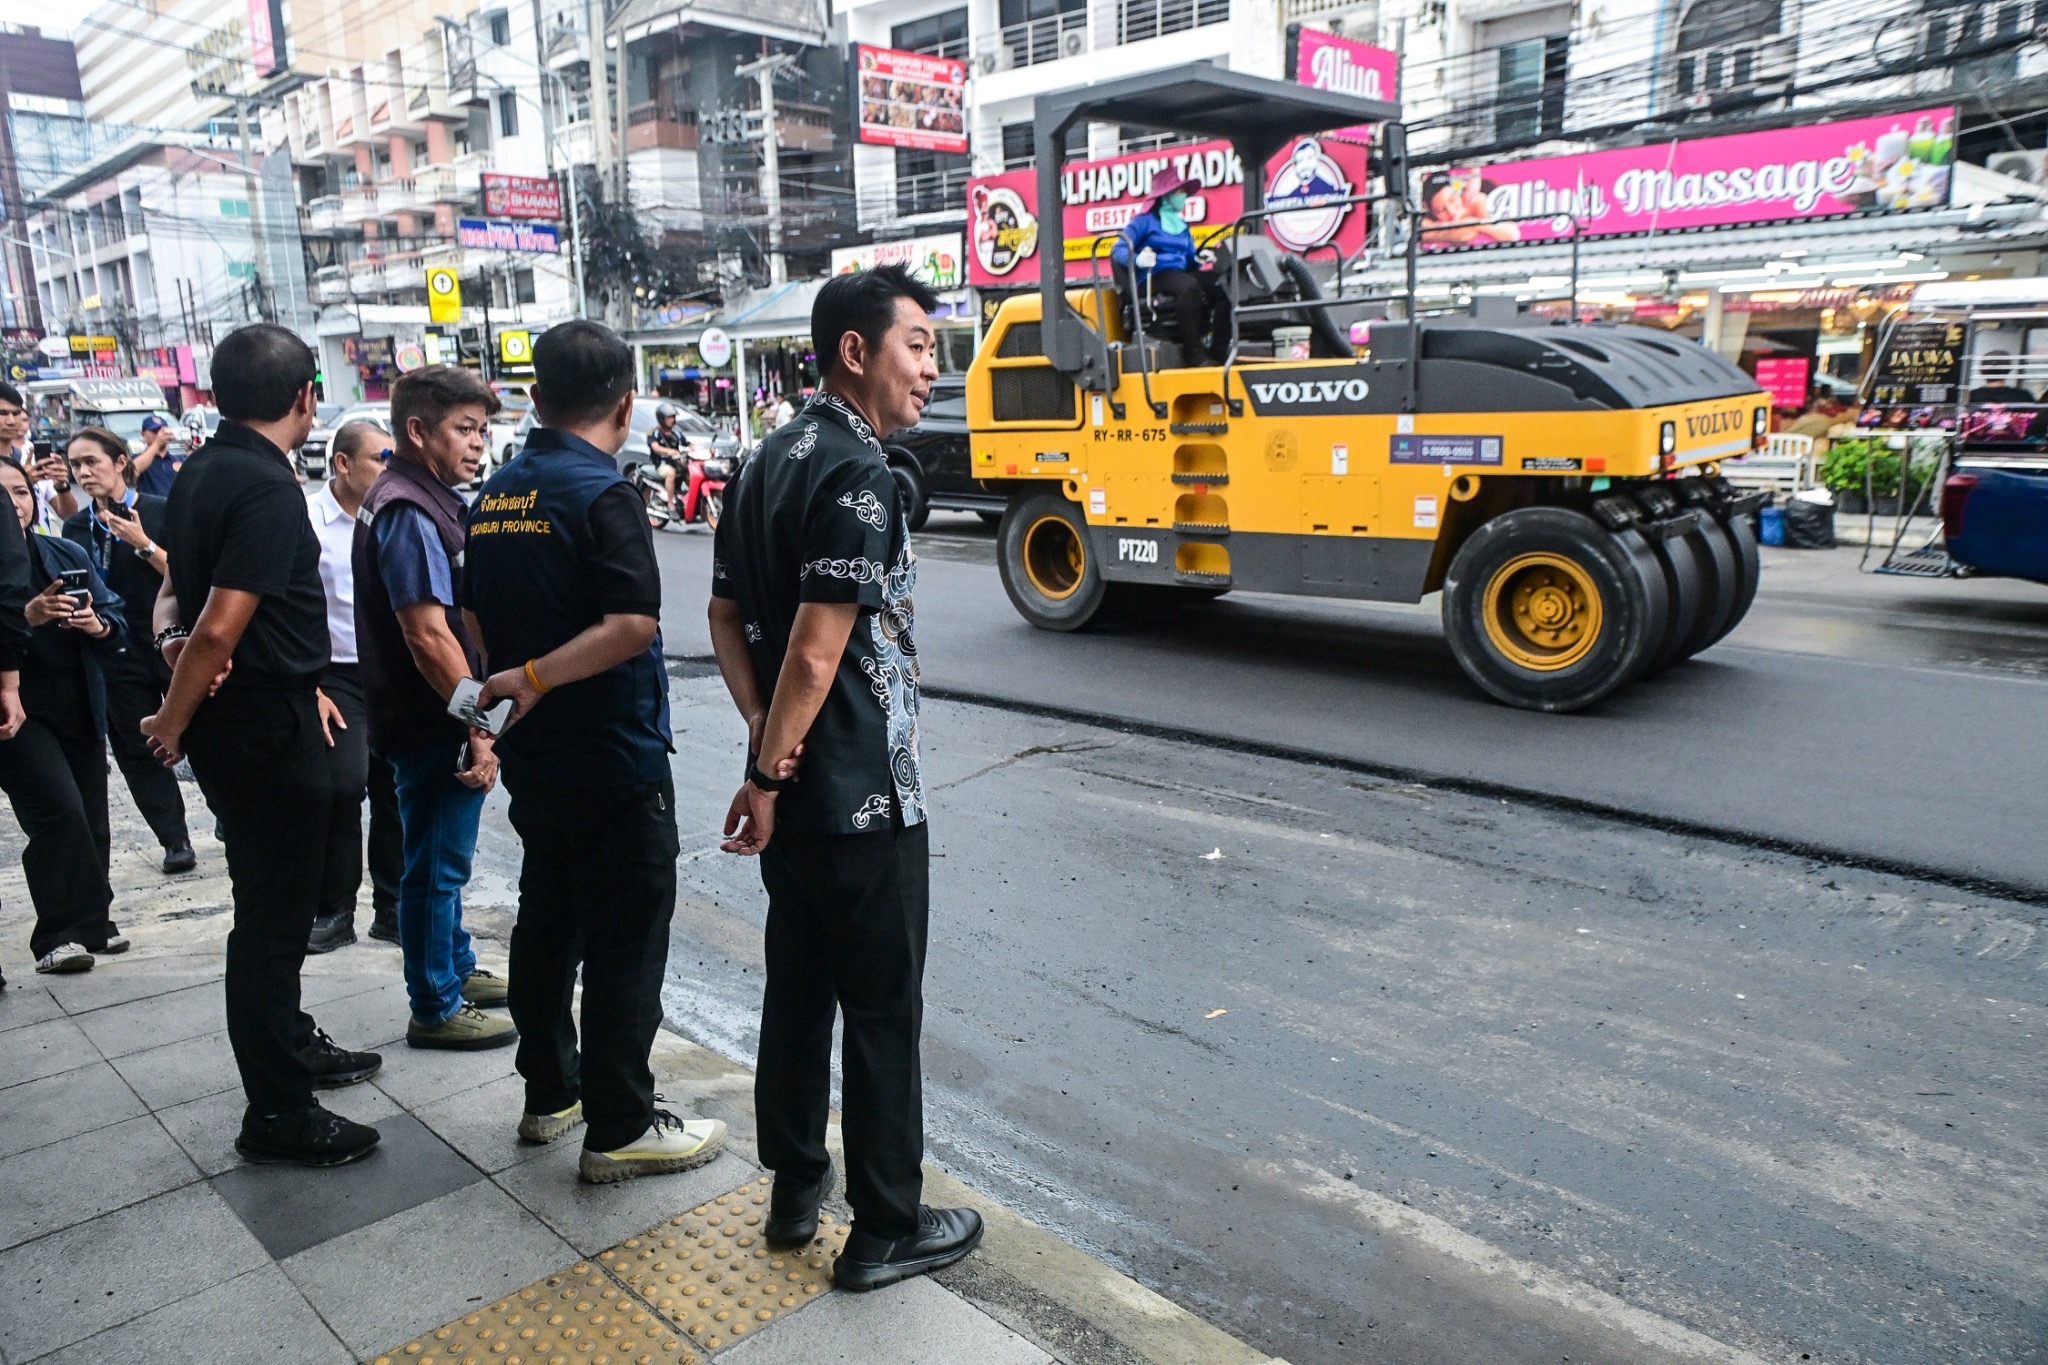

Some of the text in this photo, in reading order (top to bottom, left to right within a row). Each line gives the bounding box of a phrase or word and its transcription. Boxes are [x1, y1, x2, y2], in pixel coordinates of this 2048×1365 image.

[1613, 156, 1858, 213] Massage
[1888, 350, 1954, 367] JALWA
[1251, 379, 1370, 404] VOLVO
[1686, 410, 1744, 438] VOLVO
[481, 489, 538, 517] จังหวัดชลบุรี
[501, 520, 550, 534] PROVINCE
[1118, 538, 1159, 563] PT220
